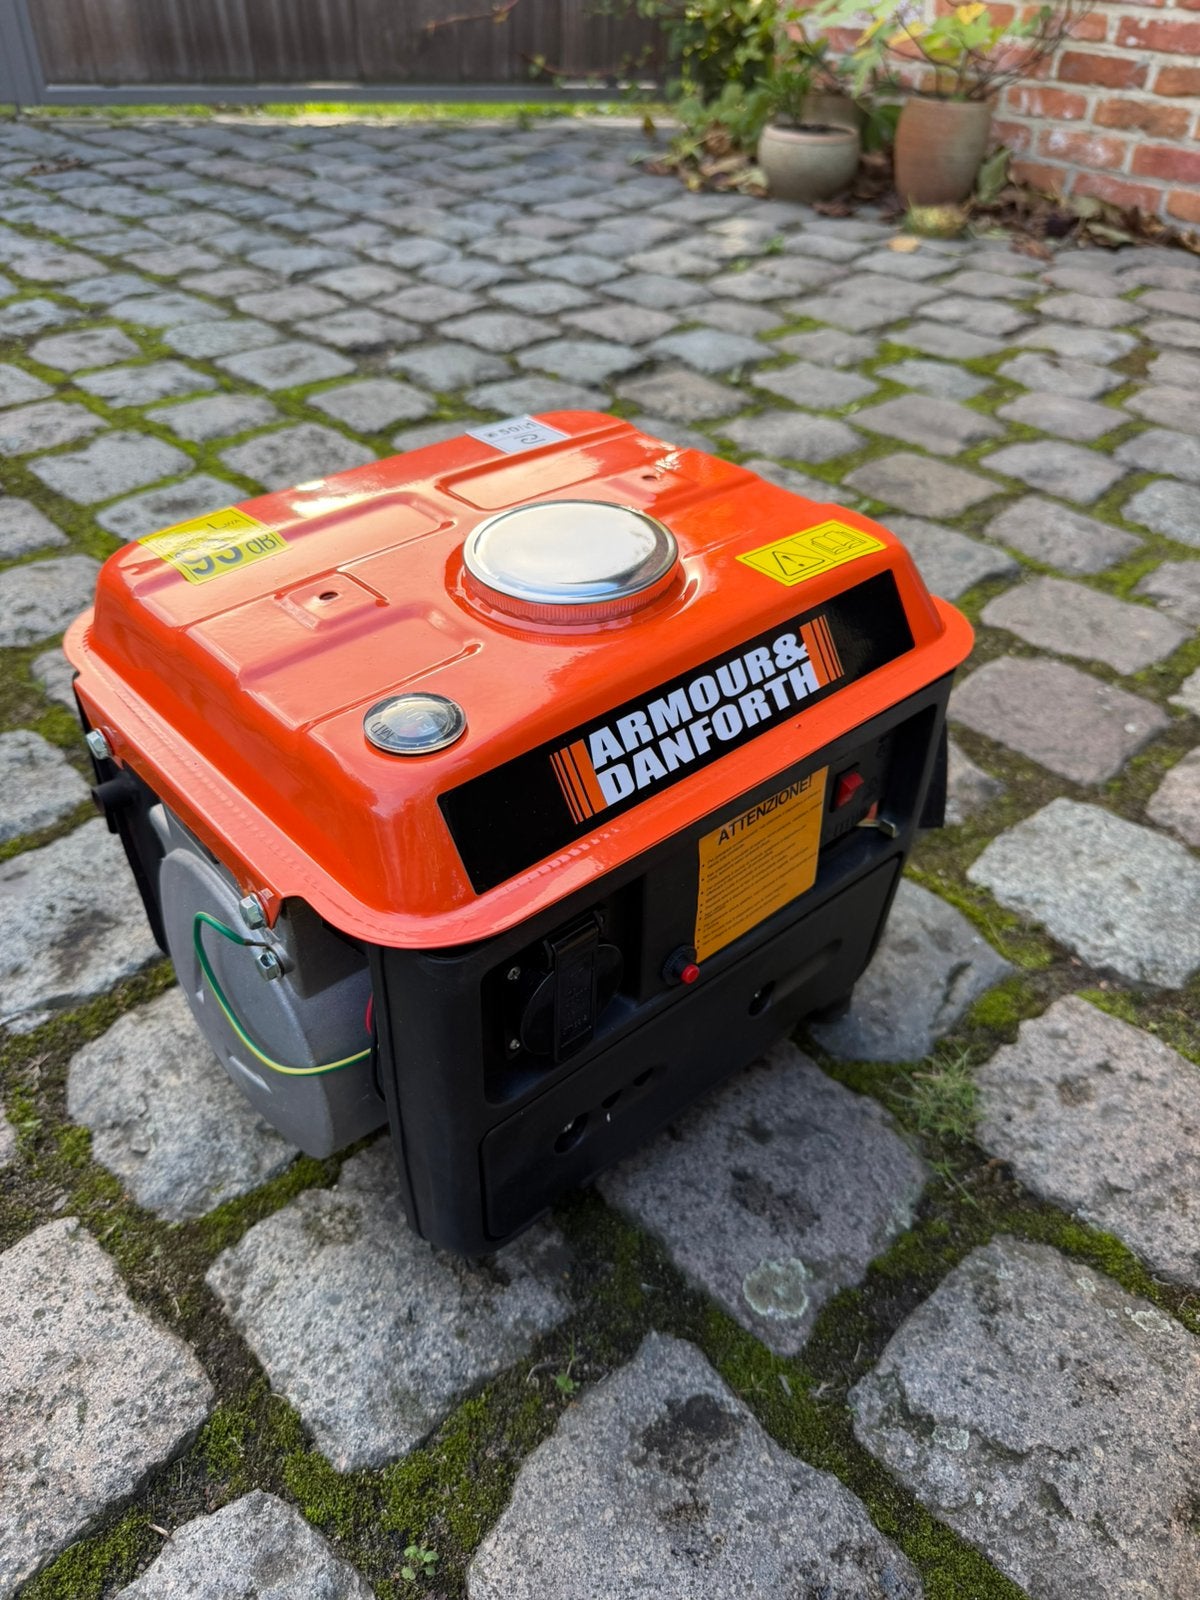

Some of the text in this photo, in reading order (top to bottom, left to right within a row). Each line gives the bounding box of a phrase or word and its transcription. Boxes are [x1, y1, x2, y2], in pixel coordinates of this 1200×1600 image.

[587, 633, 810, 770] ARMOUR&
[596, 660, 820, 806] DANFORTH
[717, 775, 813, 846] ATTENZIONE!
